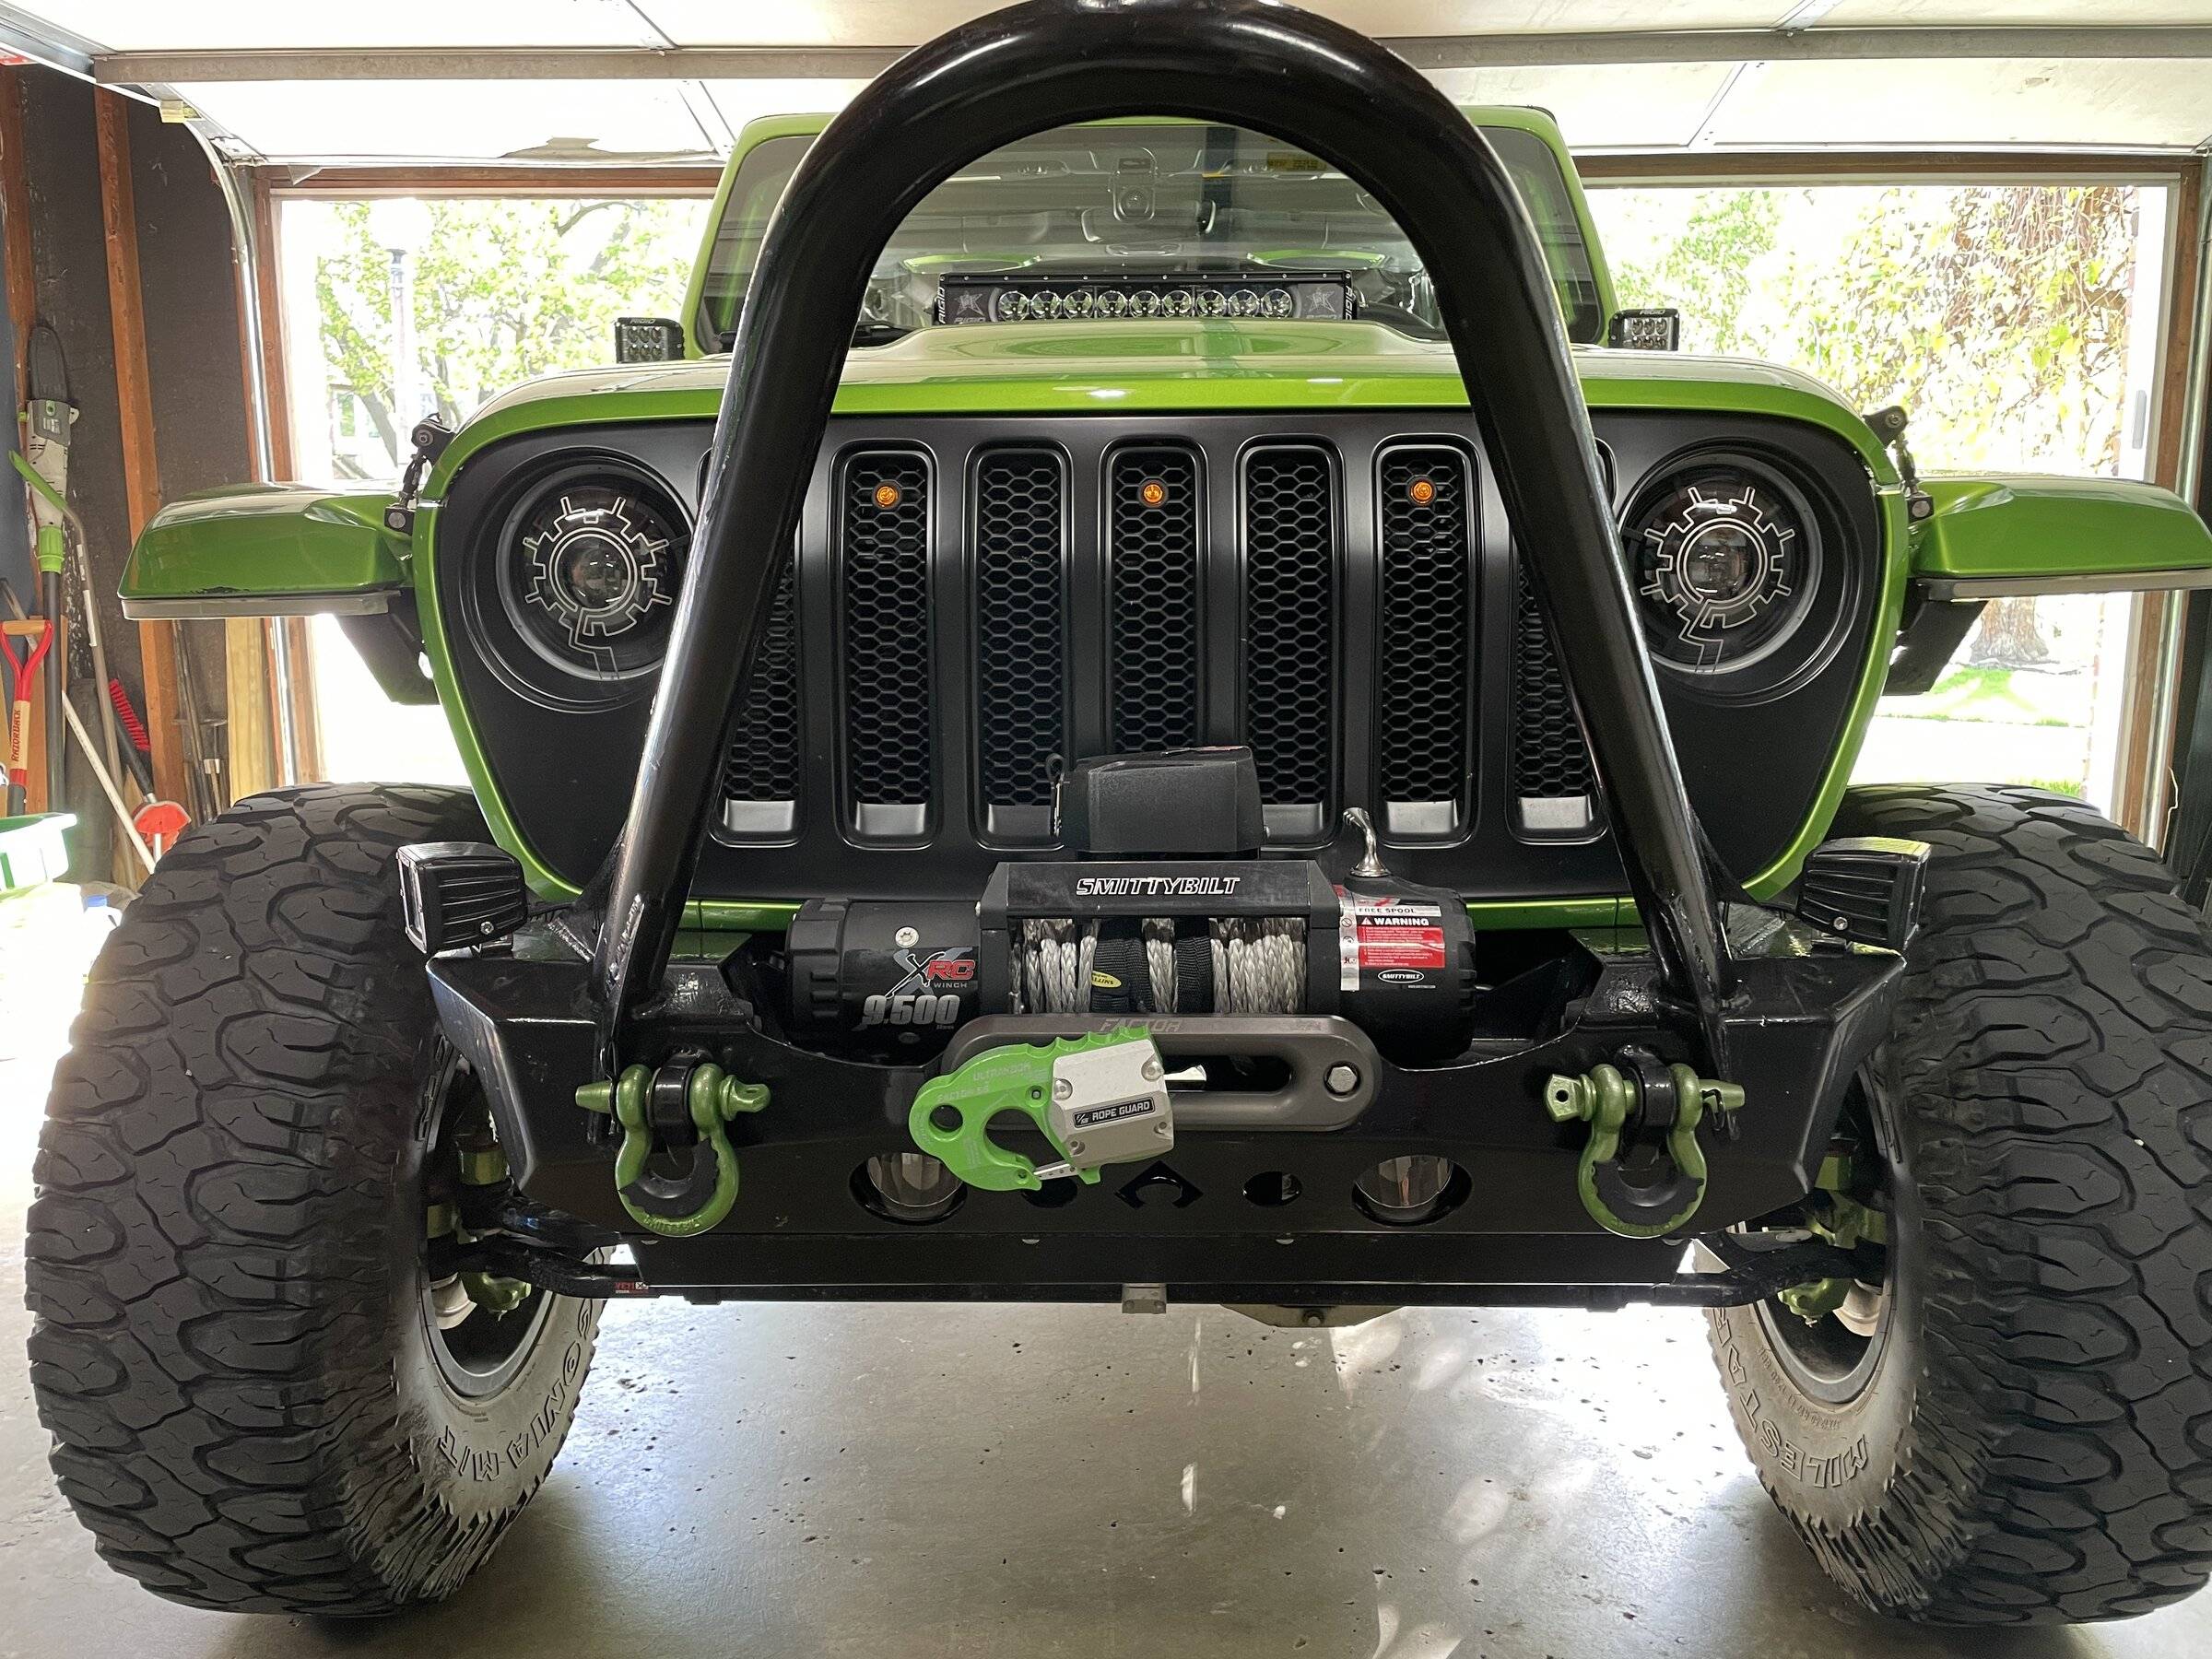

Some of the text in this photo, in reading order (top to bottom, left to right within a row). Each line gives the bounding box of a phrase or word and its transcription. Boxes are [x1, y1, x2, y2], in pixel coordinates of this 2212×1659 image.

[937, 287, 946, 324] RIGID
[1076, 877, 1241, 896] SMITTYBILT
[1373, 917, 1430, 926] WARNING
[1092, 1108, 1117, 1122] ROPE
[1119, 1101, 1150, 1116] GUARD
[506, 1299, 593, 1469] GONIA
[1712, 1307, 1870, 1489] MILESTAR
